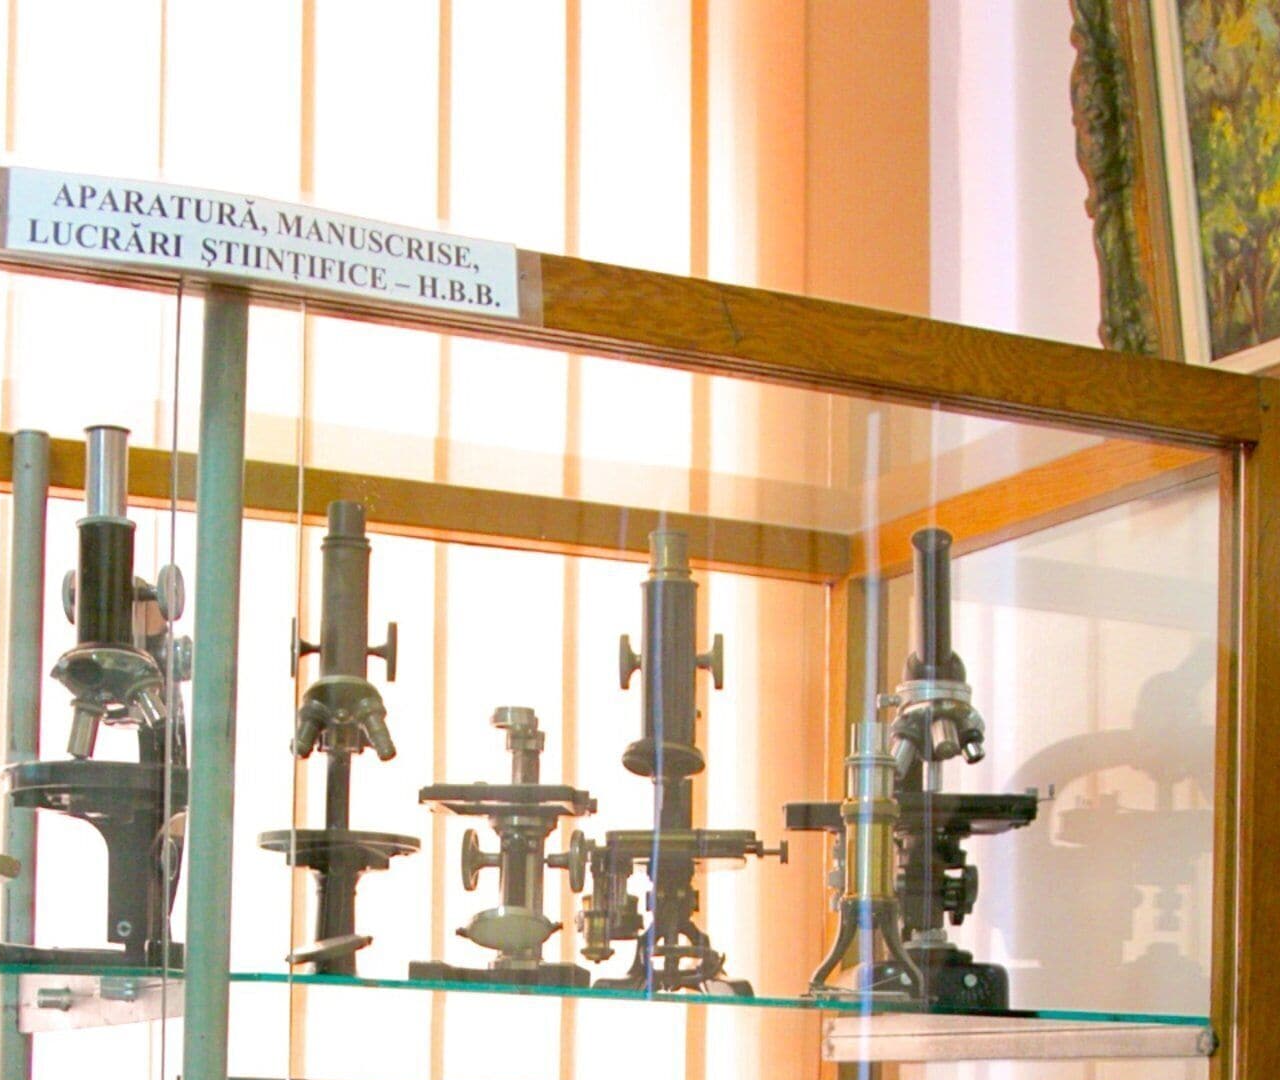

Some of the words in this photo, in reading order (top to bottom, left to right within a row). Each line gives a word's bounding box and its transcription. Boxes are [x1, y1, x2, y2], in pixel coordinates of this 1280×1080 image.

[26, 218, 184, 258] LUCRĂRI
[419, 274, 501, 307] H.B.B.
[53, 182, 268, 237] APARATURĂ,
[277, 211, 480, 273] MANUSCRISE,
